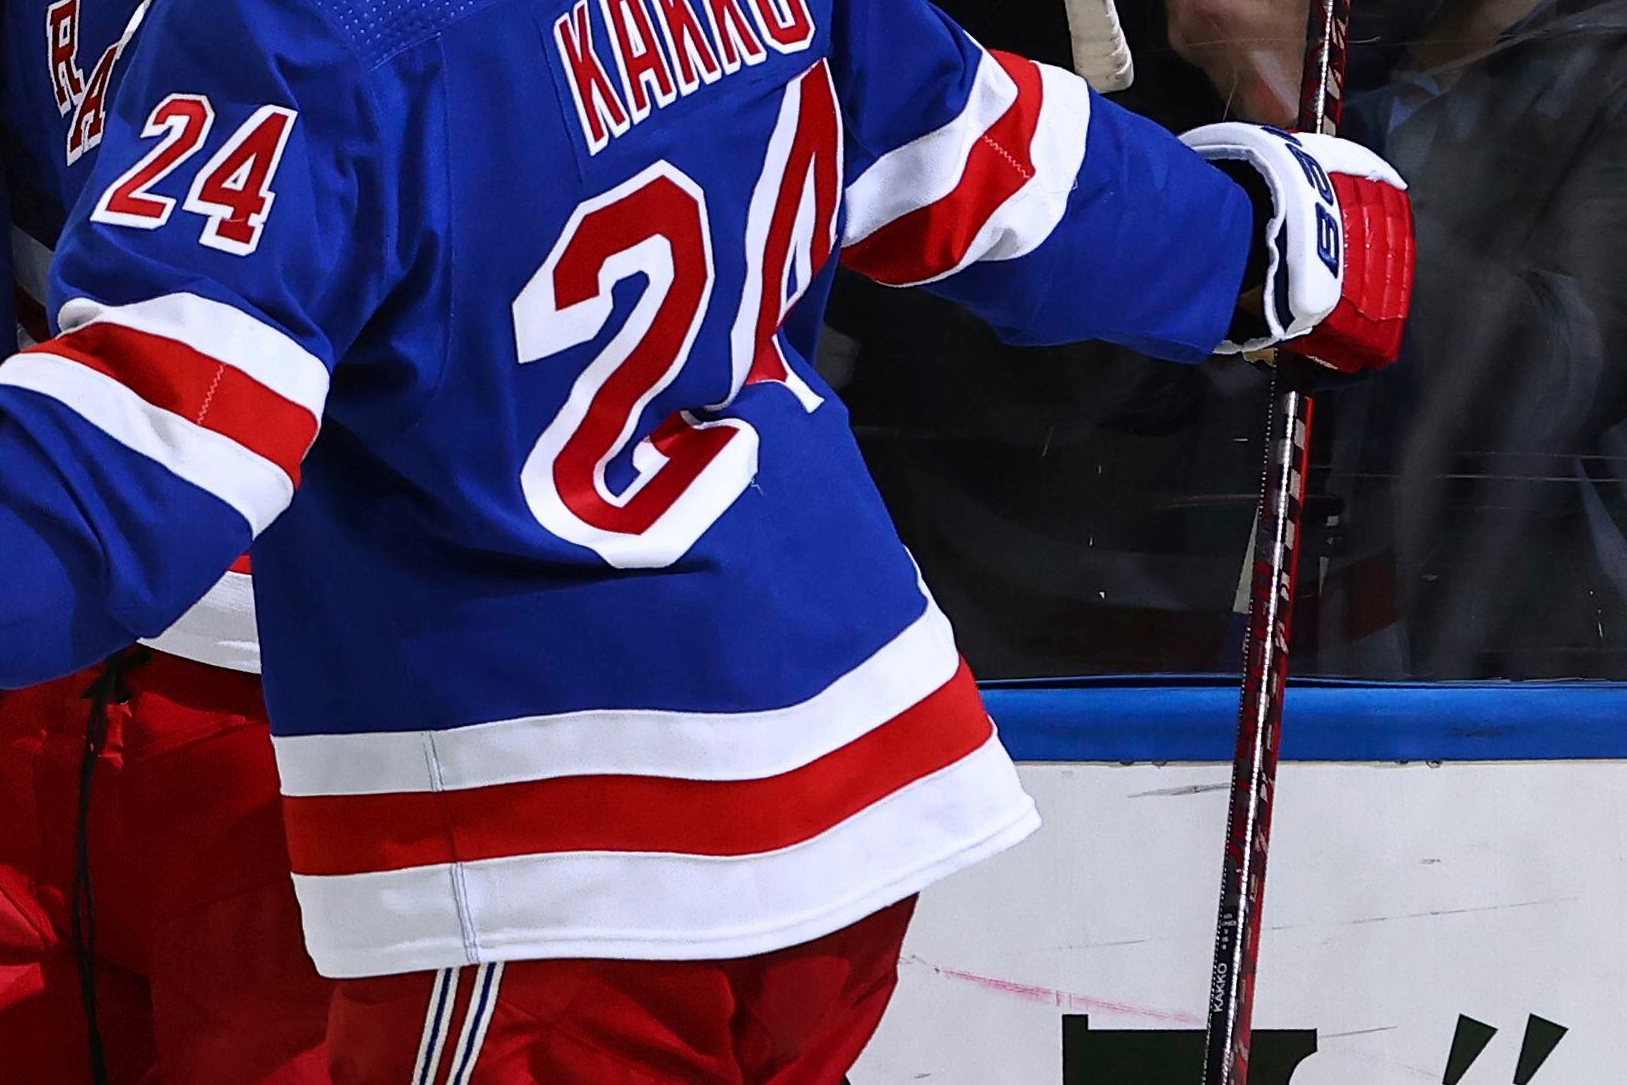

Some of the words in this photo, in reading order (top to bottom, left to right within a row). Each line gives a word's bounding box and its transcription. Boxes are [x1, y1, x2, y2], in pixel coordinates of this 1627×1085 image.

[90, 93, 298, 256] 24
[512, 57, 845, 569] 24
[1213, 962, 1228, 1013] KAKKO
